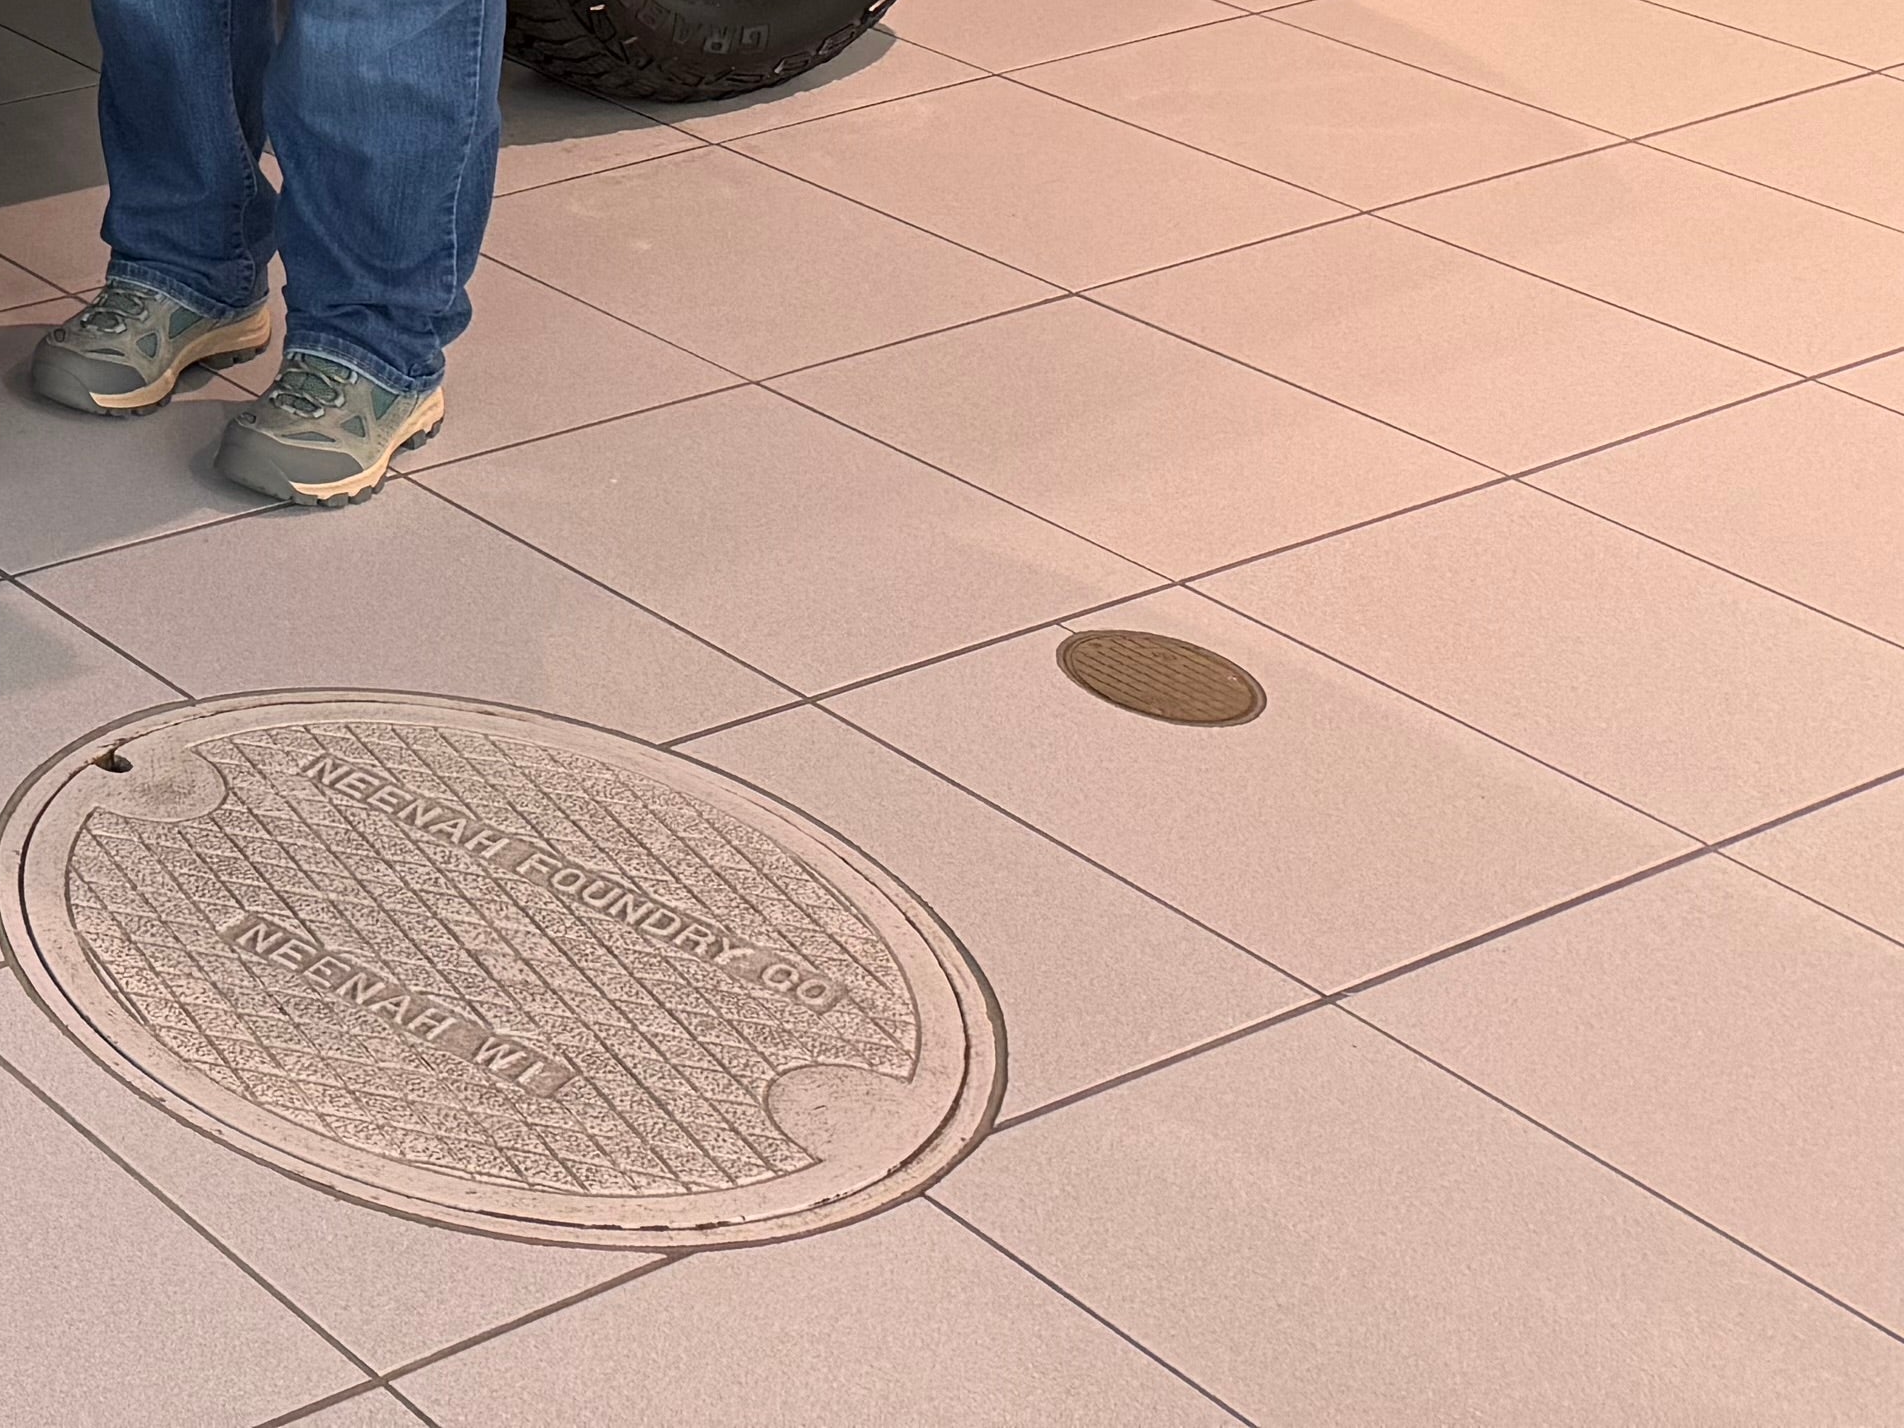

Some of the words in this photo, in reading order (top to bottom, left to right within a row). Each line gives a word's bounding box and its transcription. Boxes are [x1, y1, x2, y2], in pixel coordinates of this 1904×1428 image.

[303, 753, 509, 858] NEENAH
[515, 849, 752, 964] FOUNDRY
[239, 919, 458, 1041] NEENAH
